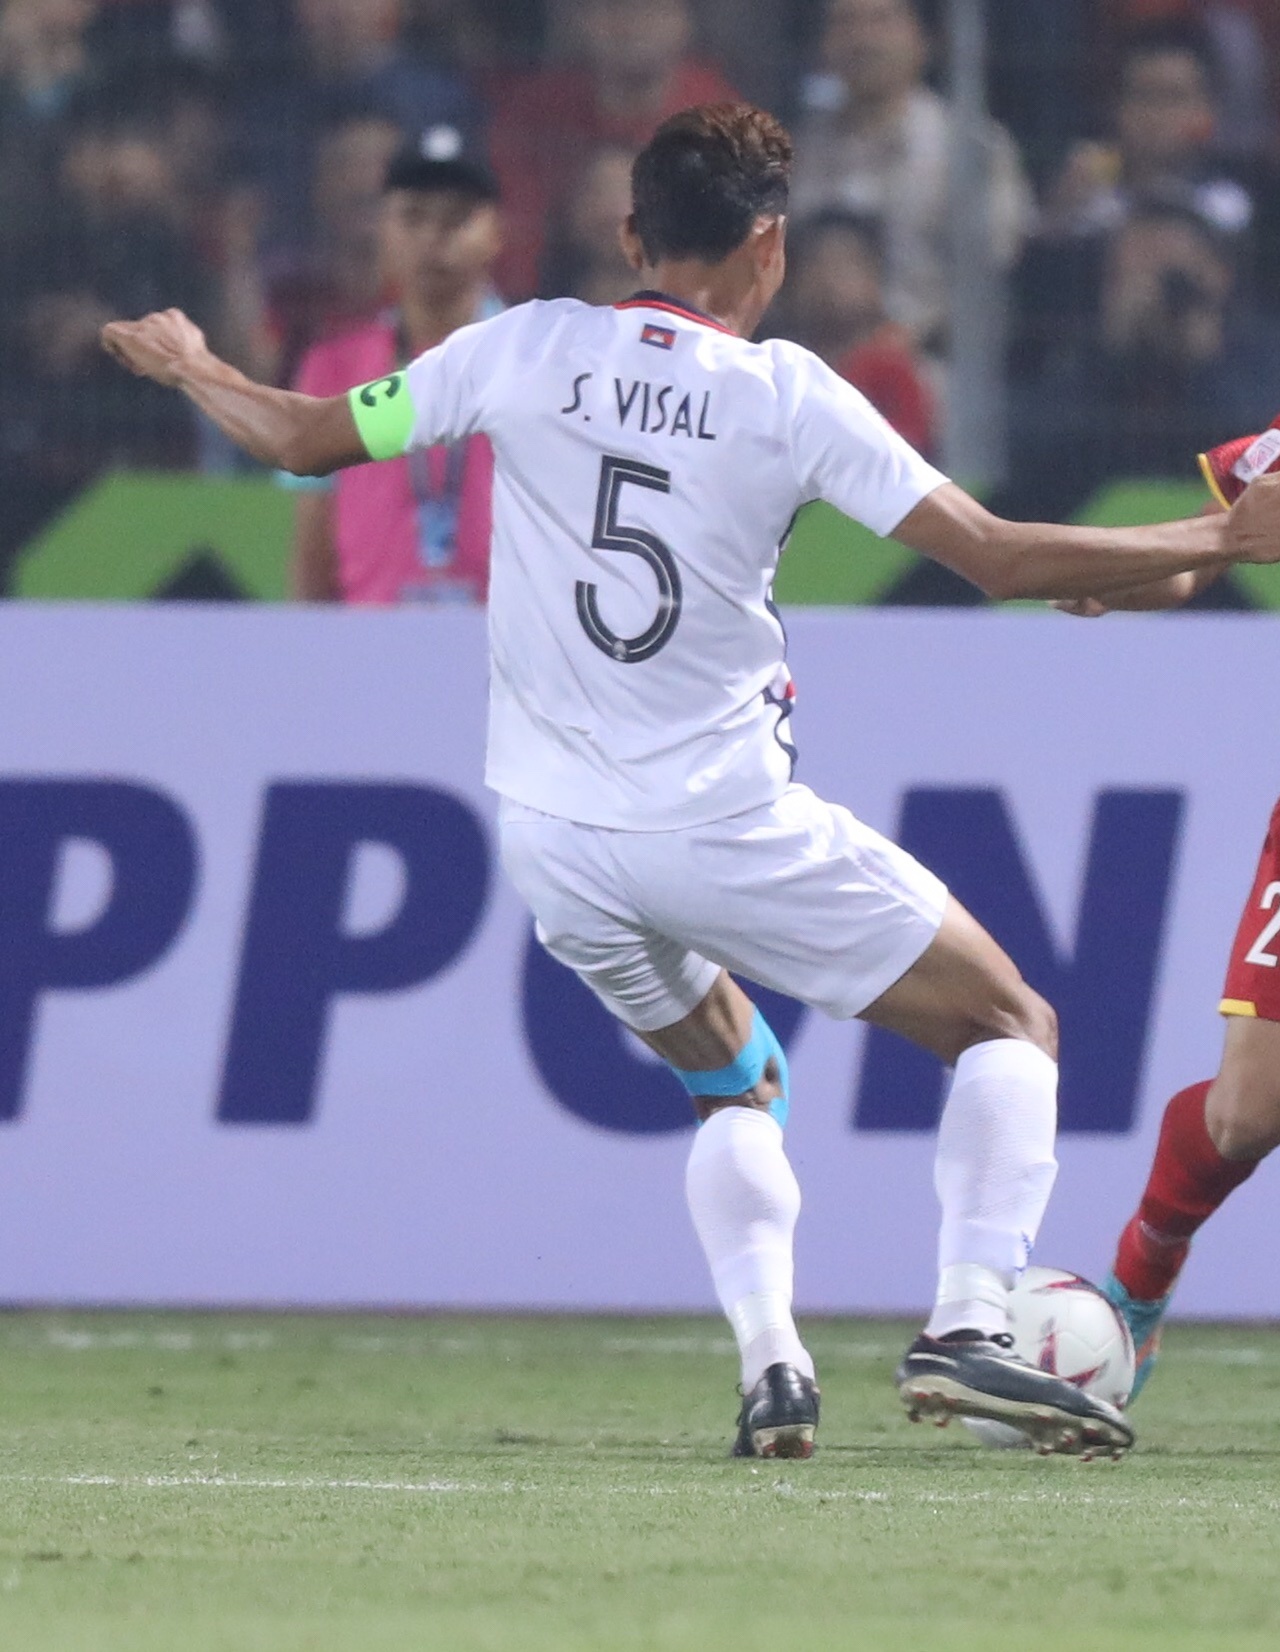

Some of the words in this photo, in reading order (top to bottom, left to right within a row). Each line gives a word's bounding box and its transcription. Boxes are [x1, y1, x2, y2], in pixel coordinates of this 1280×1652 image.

[360, 375, 401, 407] C
[561, 372, 593, 421] S.
[614, 377, 717, 441] VISAL
[576, 454, 682, 663] 5
